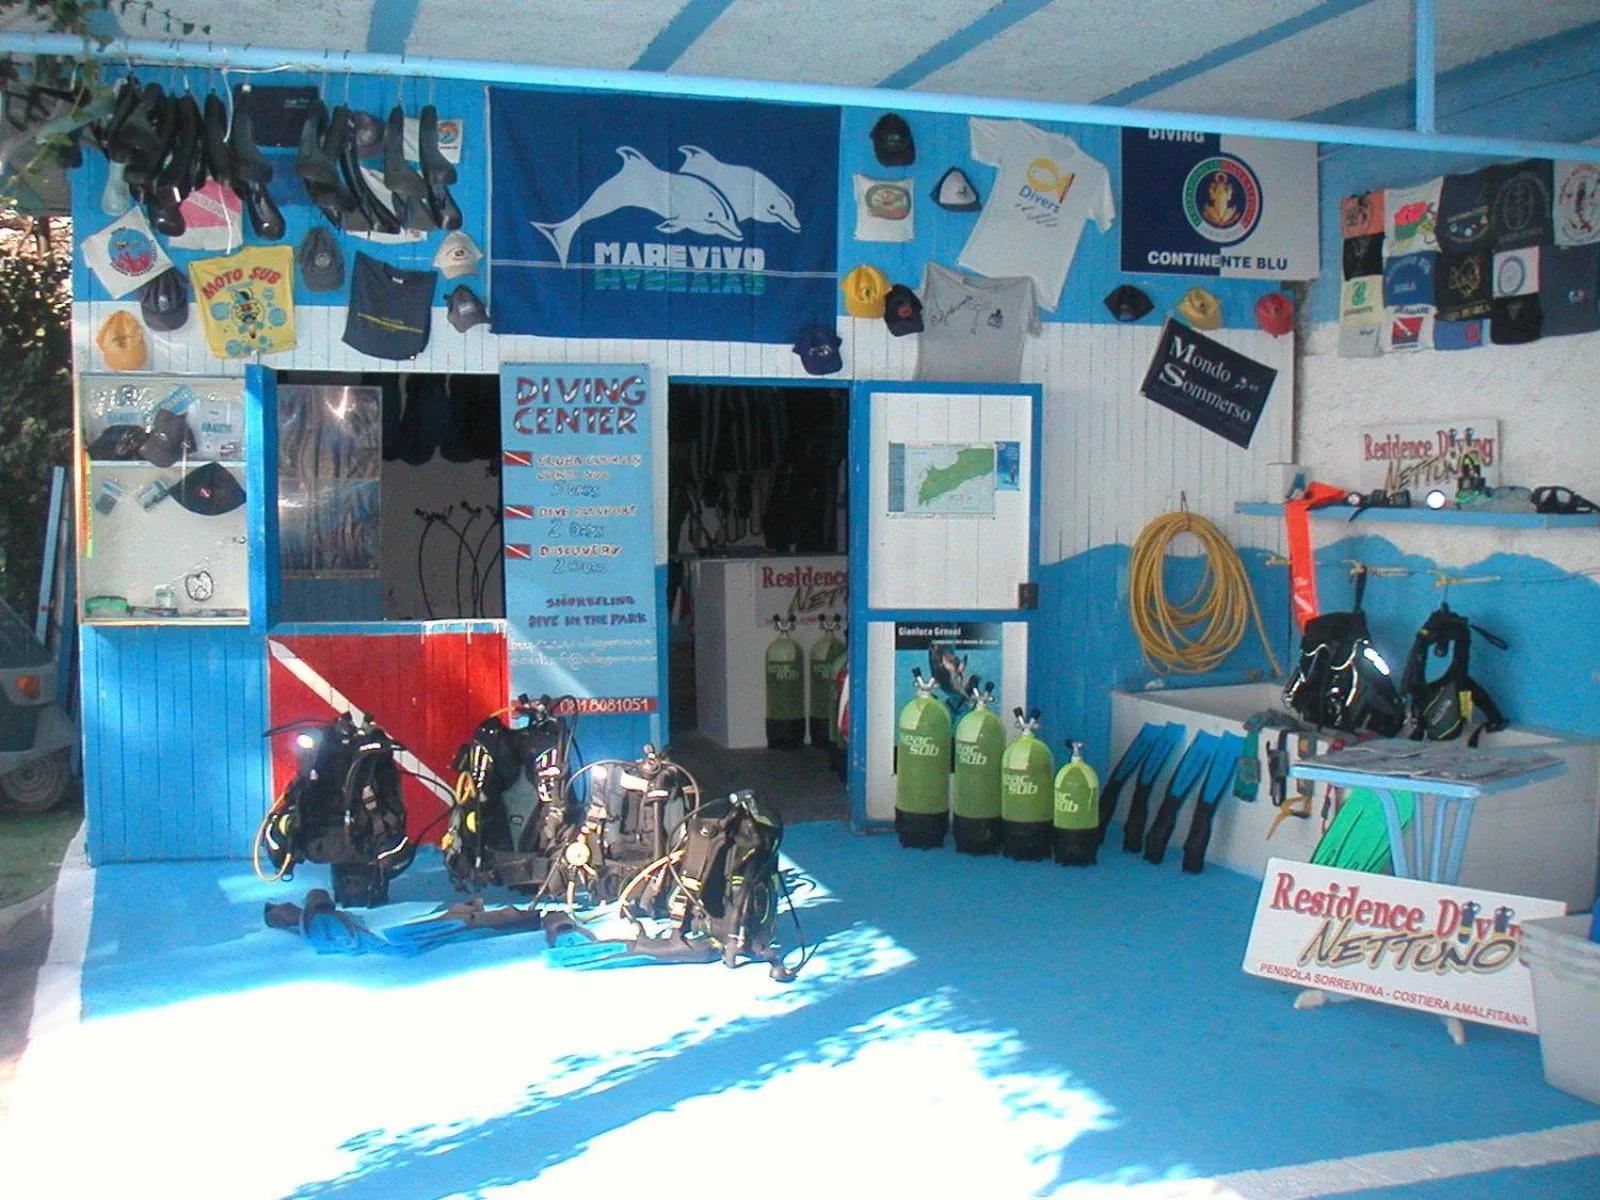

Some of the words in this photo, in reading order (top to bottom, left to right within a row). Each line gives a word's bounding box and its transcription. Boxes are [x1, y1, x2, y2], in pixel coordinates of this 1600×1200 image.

[1147, 251, 1251, 269] CONTINENTE
[1256, 257, 1288, 270] BLU
[201, 268, 243, 300] MOTO
[249, 266, 283, 286] SUB
[1168, 335, 1232, 383] Mondo
[516, 376, 647, 406] DIVING
[1158, 362, 1252, 423] Sommerso
[513, 406, 639, 436] CENTER
[1363, 433, 1433, 462] Residence
[538, 506, 569, 519] DIVE
[539, 543, 622, 558] DISCOVERY
[527, 614, 559, 629] DIVE
[583, 614, 608, 626] THE
[610, 612, 647, 626] PARK
[1270, 872, 1425, 933] Residence
[1296, 918, 1519, 976] NETTUNO
[1312, 972, 1384, 998] SORRENTINA
[1392, 989, 1450, 1011] COSTIERA
[1453, 1002, 1529, 1026] AMALFITANA
